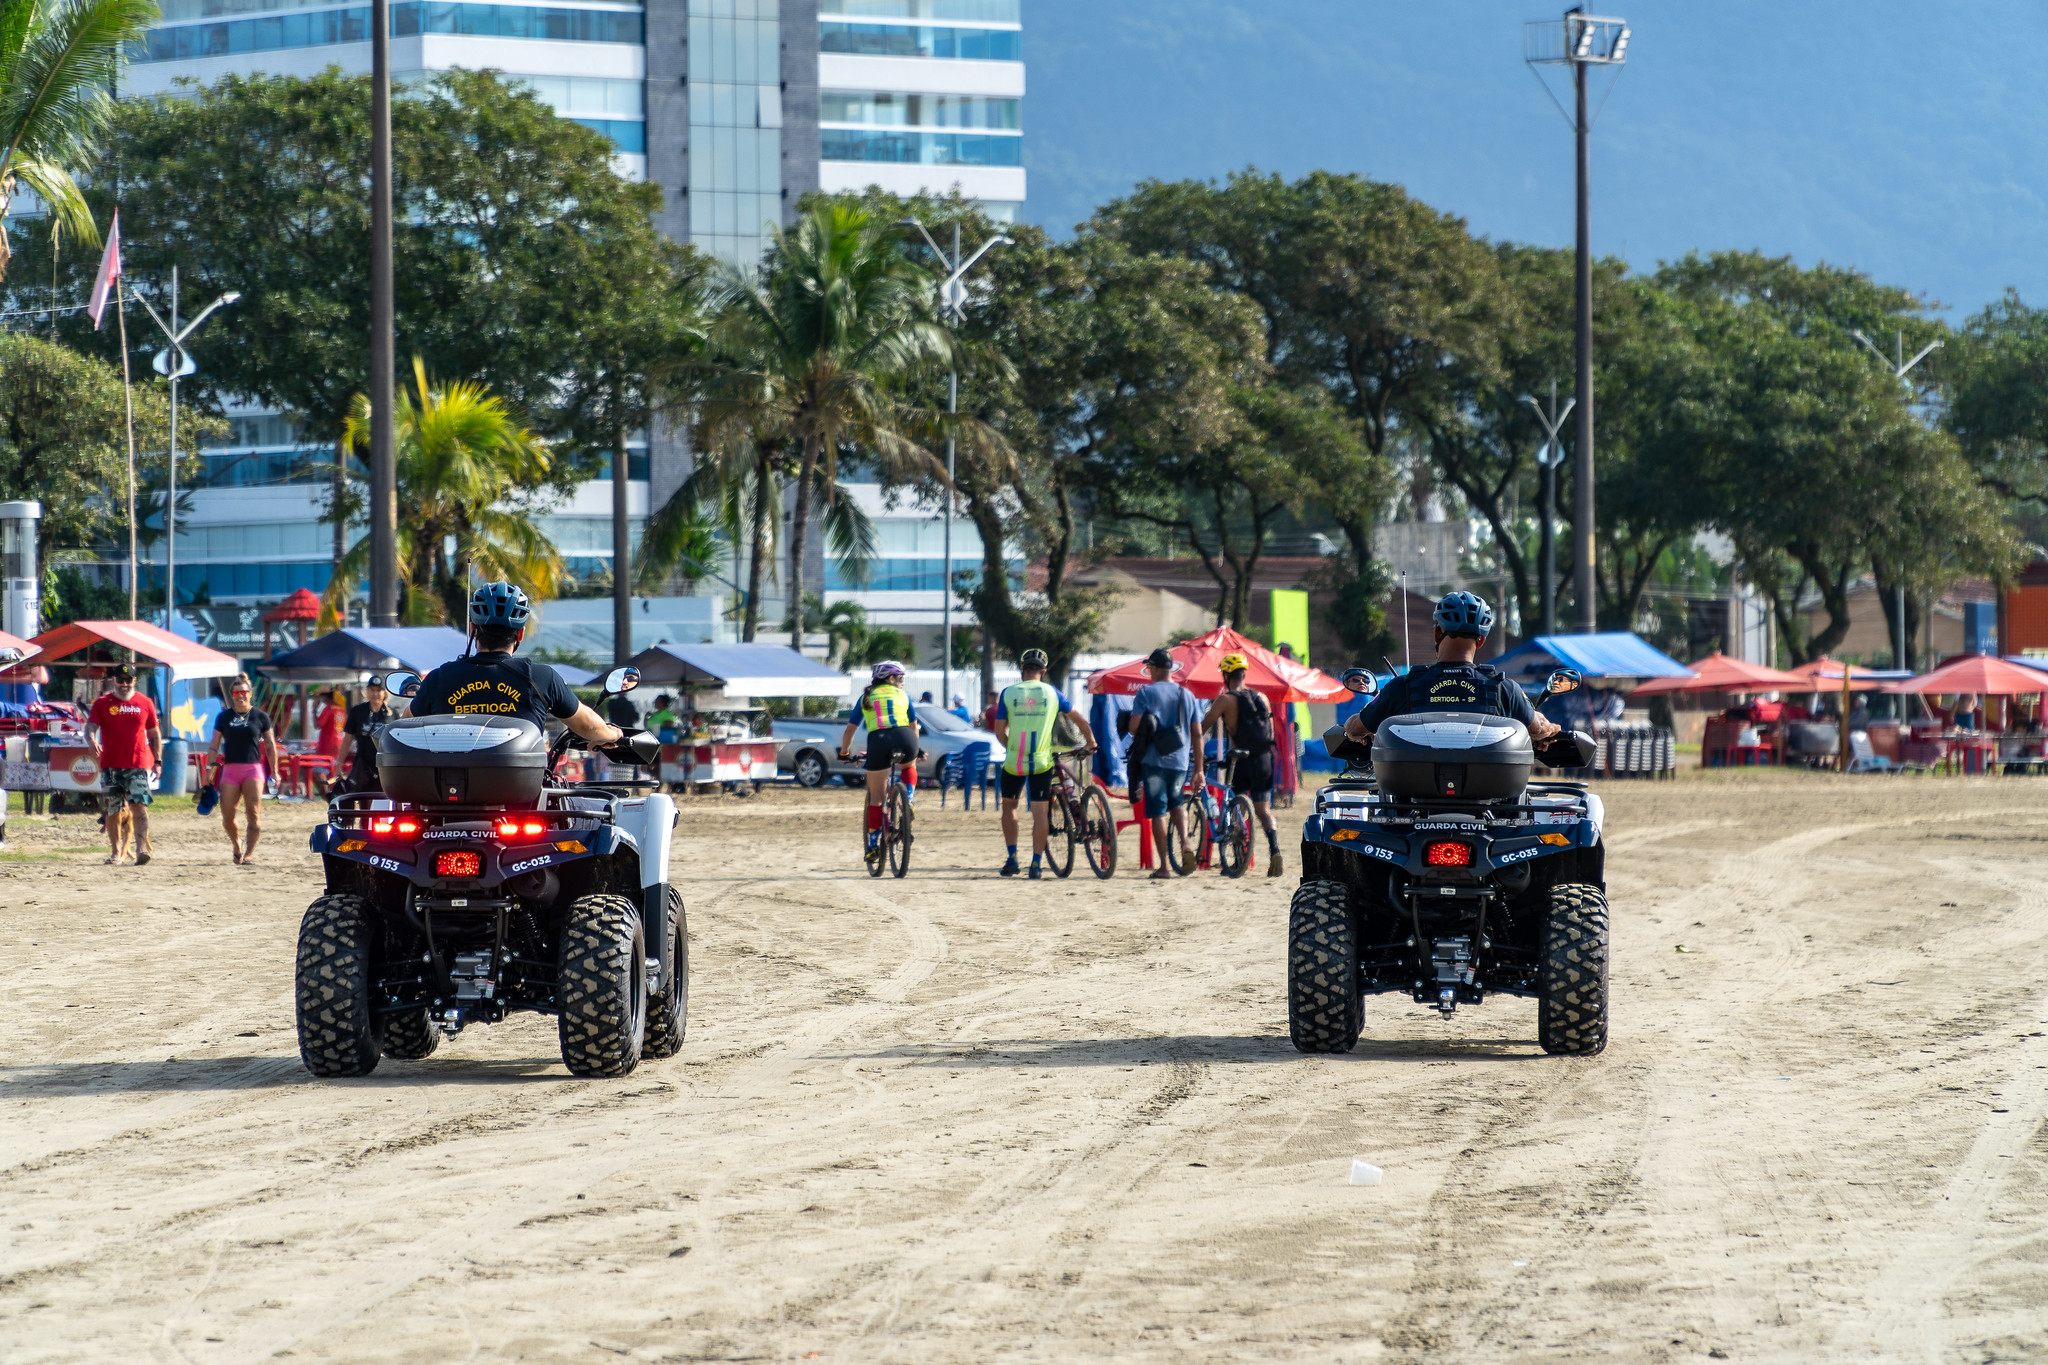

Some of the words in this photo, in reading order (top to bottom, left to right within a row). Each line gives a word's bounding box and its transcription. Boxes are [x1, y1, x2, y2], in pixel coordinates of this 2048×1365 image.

[448, 680, 491, 705] GUARDA
[497, 682, 521, 702] CIVIL
[1430, 679, 1457, 693] GUARDA
[1460, 680, 1476, 693] CIVIL
[119, 704, 141, 714] Aloha
[455, 702, 517, 714] BERTIOGA
[1460, 823, 1487, 831] CIVIL
[423, 831, 468, 839] GUARDA
[471, 831, 499, 839] CIVIL
[1375, 847, 1394, 860] 153
[1501, 848, 1538, 863] GC-035
[380, 857, 400, 871] 153
[512, 855, 552, 872] GC-032
